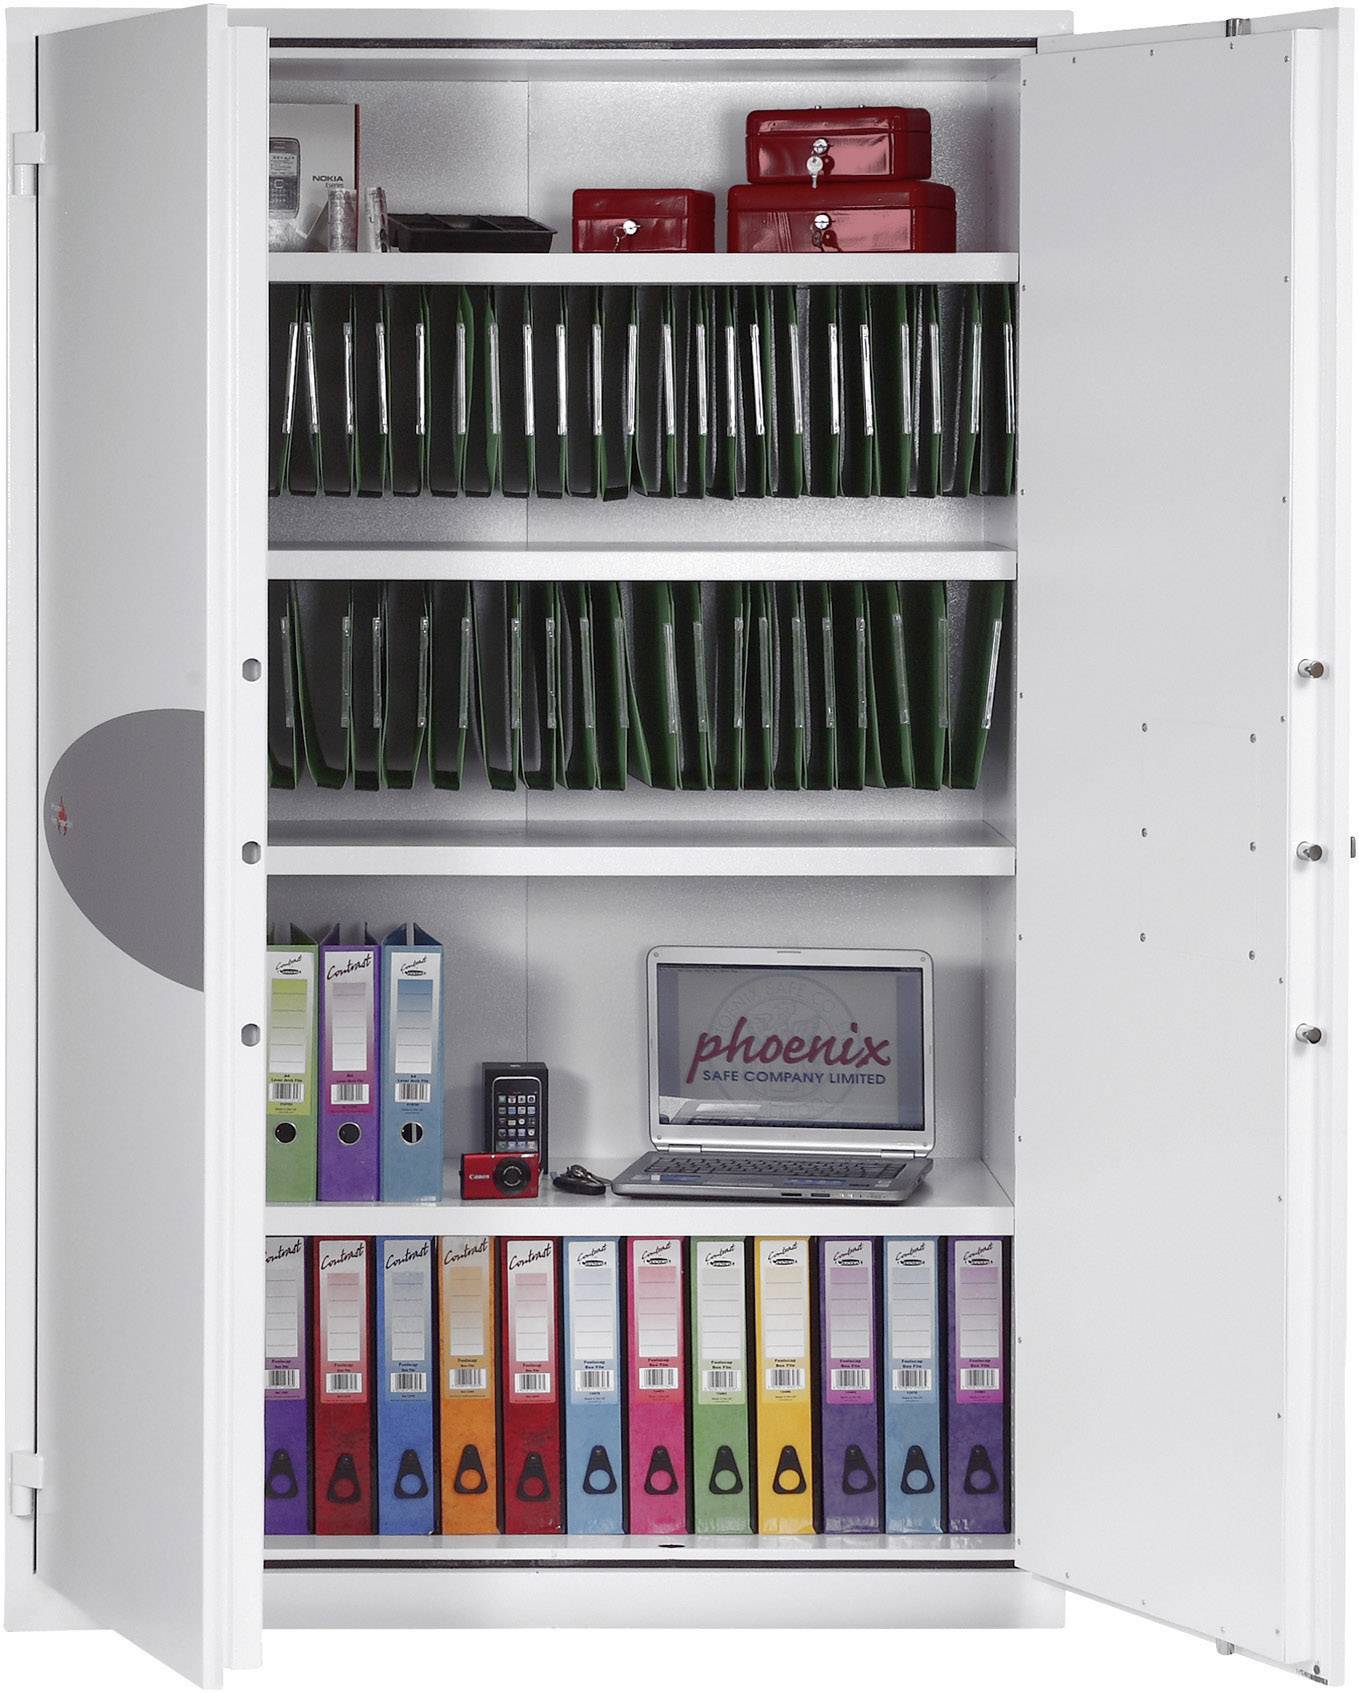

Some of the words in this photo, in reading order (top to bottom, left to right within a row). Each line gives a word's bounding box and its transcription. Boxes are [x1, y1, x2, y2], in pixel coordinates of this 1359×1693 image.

[326, 953, 372, 980] Contrast
[686, 1016, 892, 1084] phoenix
[703, 1070, 738, 1082] SAFE
[744, 1071, 824, 1084] COMPANY
[829, 1072, 886, 1085] LIMITED
[265, 1240, 302, 1263] ontrast
[320, 1242, 364, 1270] Contrast
[385, 1242, 429, 1270] Contrast
[444, 1238, 488, 1266] Contrast
[509, 1242, 552, 1270] Contrast
